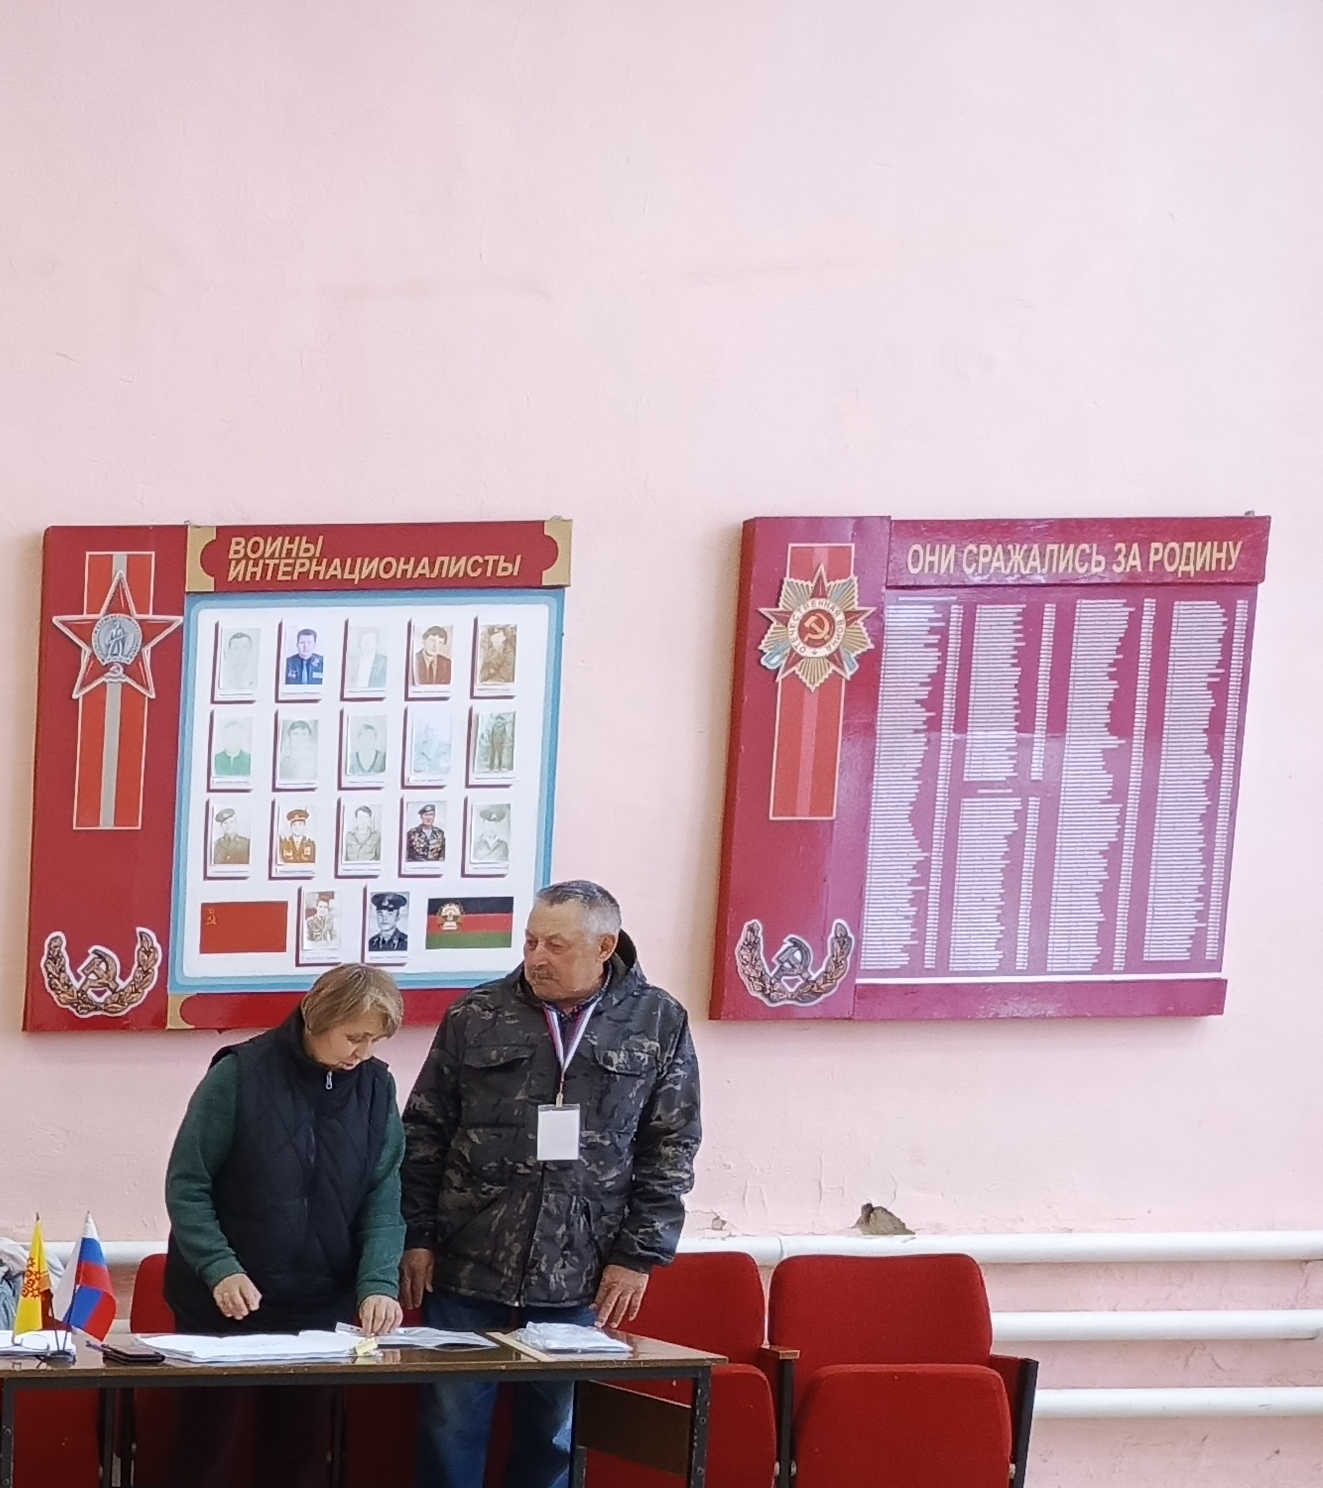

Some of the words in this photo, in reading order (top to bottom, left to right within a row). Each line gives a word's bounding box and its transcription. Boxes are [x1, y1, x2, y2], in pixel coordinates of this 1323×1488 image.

[228, 536, 323, 559] ВОИНЫ
[906, 544, 955, 574] ОНИ
[962, 543, 1106, 574] СРАЖАЛИСЬ
[1112, 542, 1142, 573] ЗА
[1148, 540, 1243, 577] РОДИНУ
[227, 555, 522, 584] ИНТЕРНАЦИОНАЛИСТЫ
